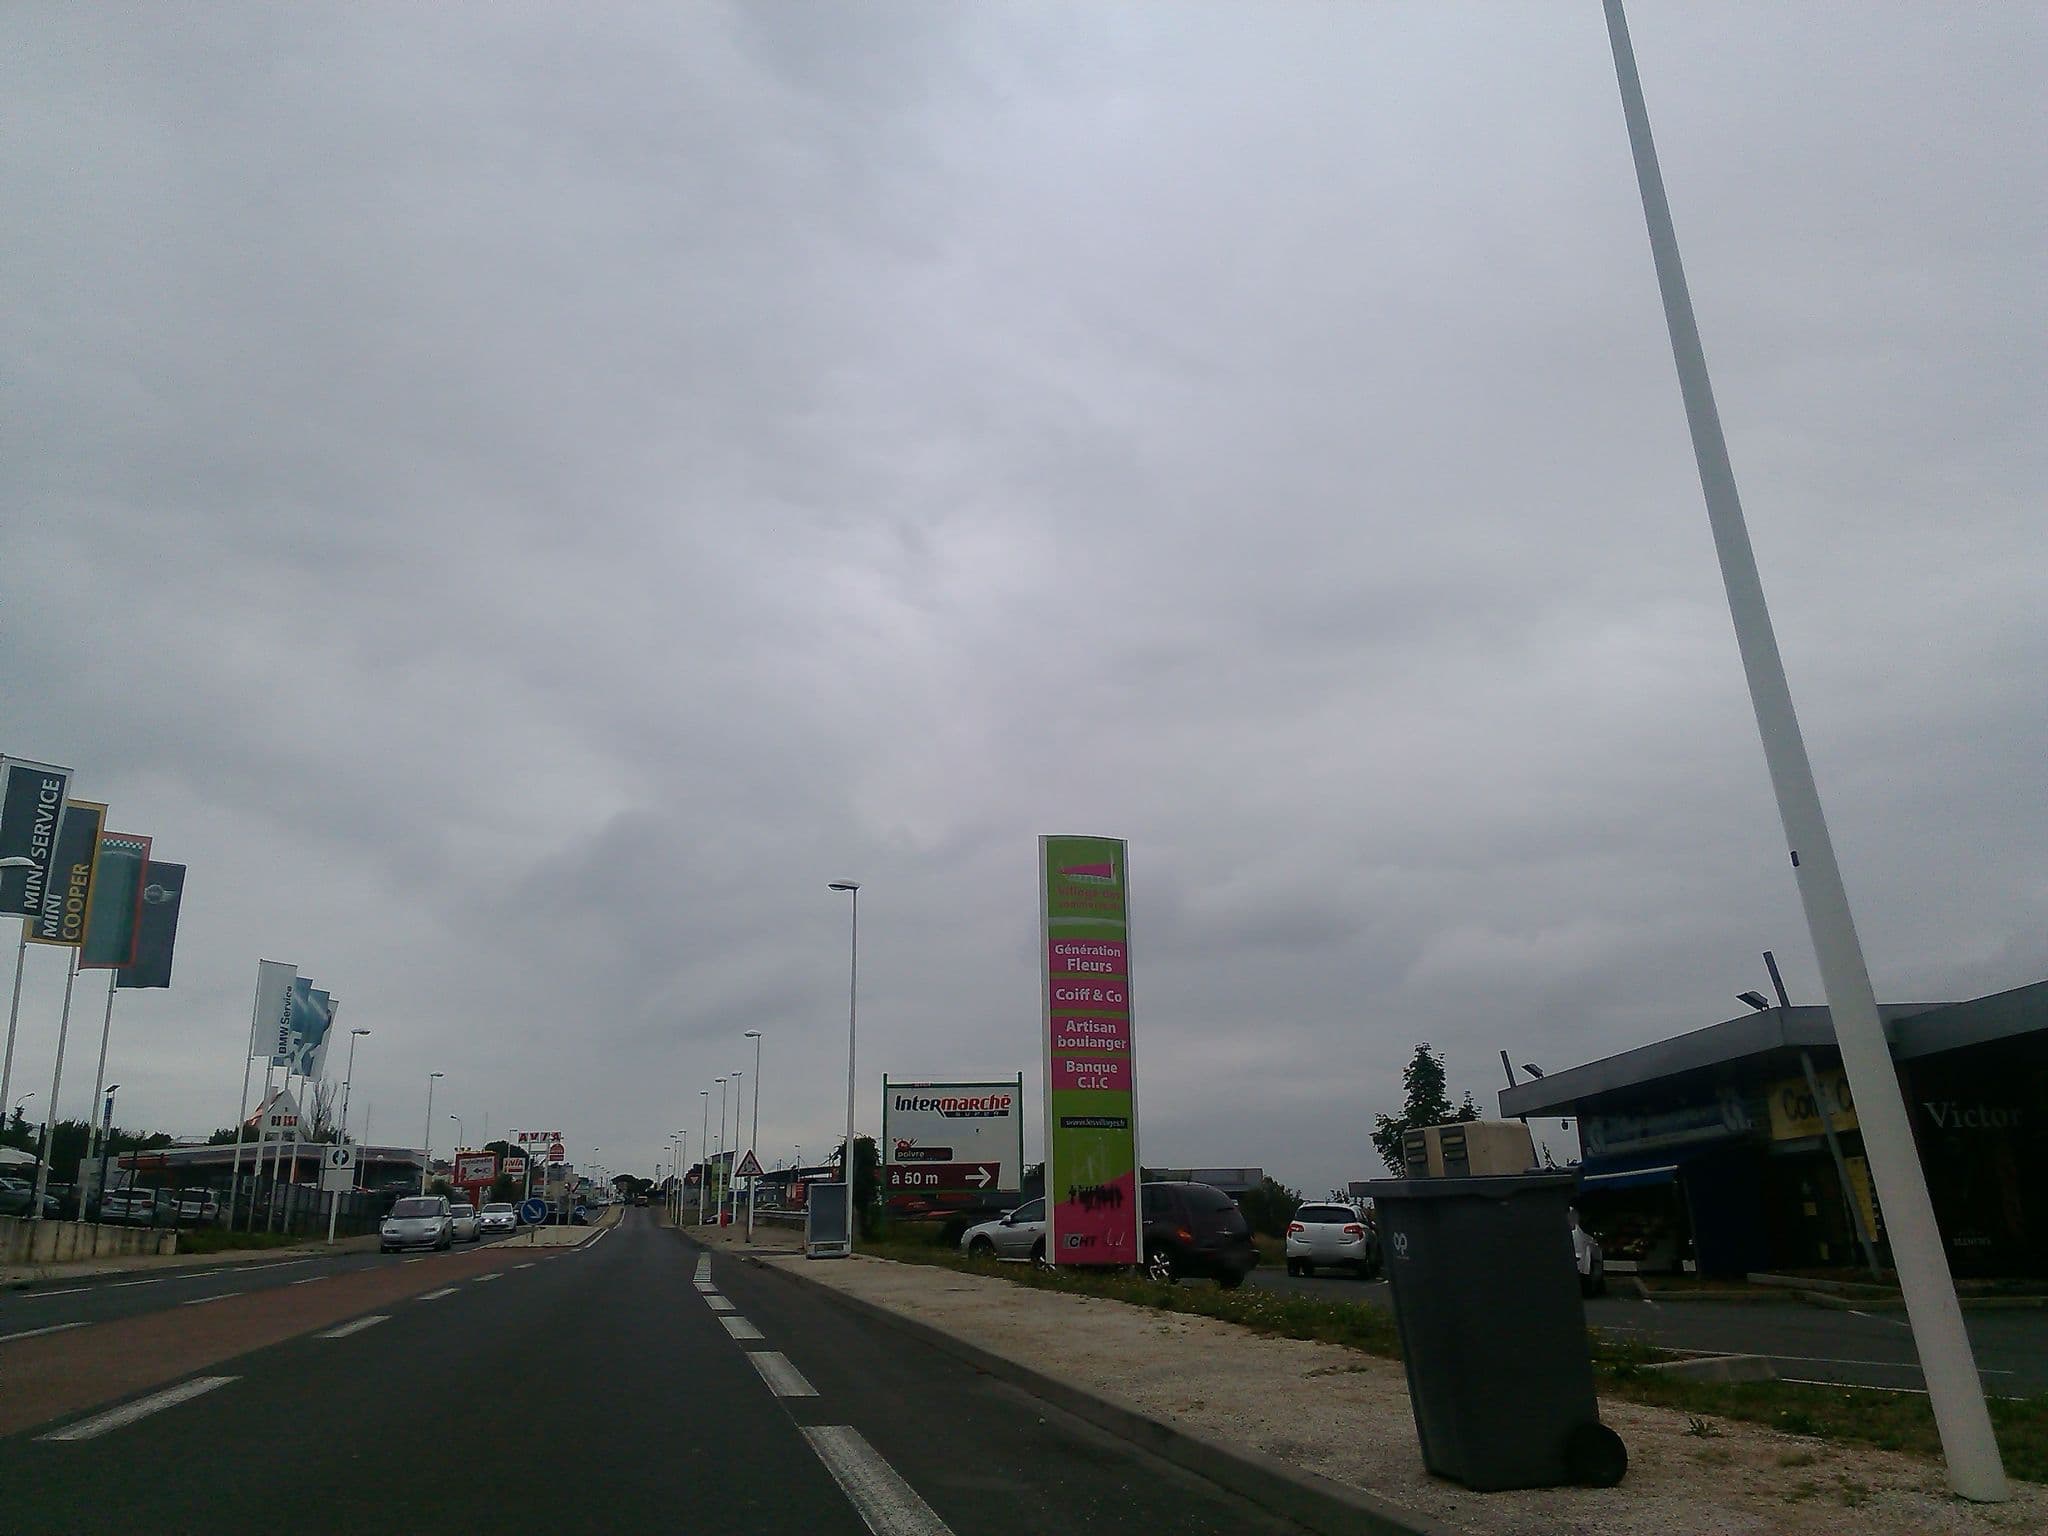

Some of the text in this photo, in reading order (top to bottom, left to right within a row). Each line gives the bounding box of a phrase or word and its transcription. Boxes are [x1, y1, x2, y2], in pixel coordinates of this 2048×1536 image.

[24, 779, 60, 909] MINI SERVICE
[61, 863, 89, 939] COOPER
[43, 893, 62, 938] MINI
[1055, 944, 1121, 957] Génération
[1067, 958, 1113, 972] Fleurs
[1055, 988, 1122, 1003] Coiff & Co
[278, 985, 293, 1054] BMW Service
[1066, 1020, 1117, 1034] Artisan
[1057, 1035, 1127, 1050] boulanger
[1066, 1061, 1118, 1075] Banque
[1077, 1077, 1109, 1089] C.I.C
[895, 1095, 1012, 1114] Intermarché
[1926, 1099, 2023, 1129] Victor
[518, 1131, 561, 1142] AVIA
[891, 1171, 939, 1185] à 50 m
